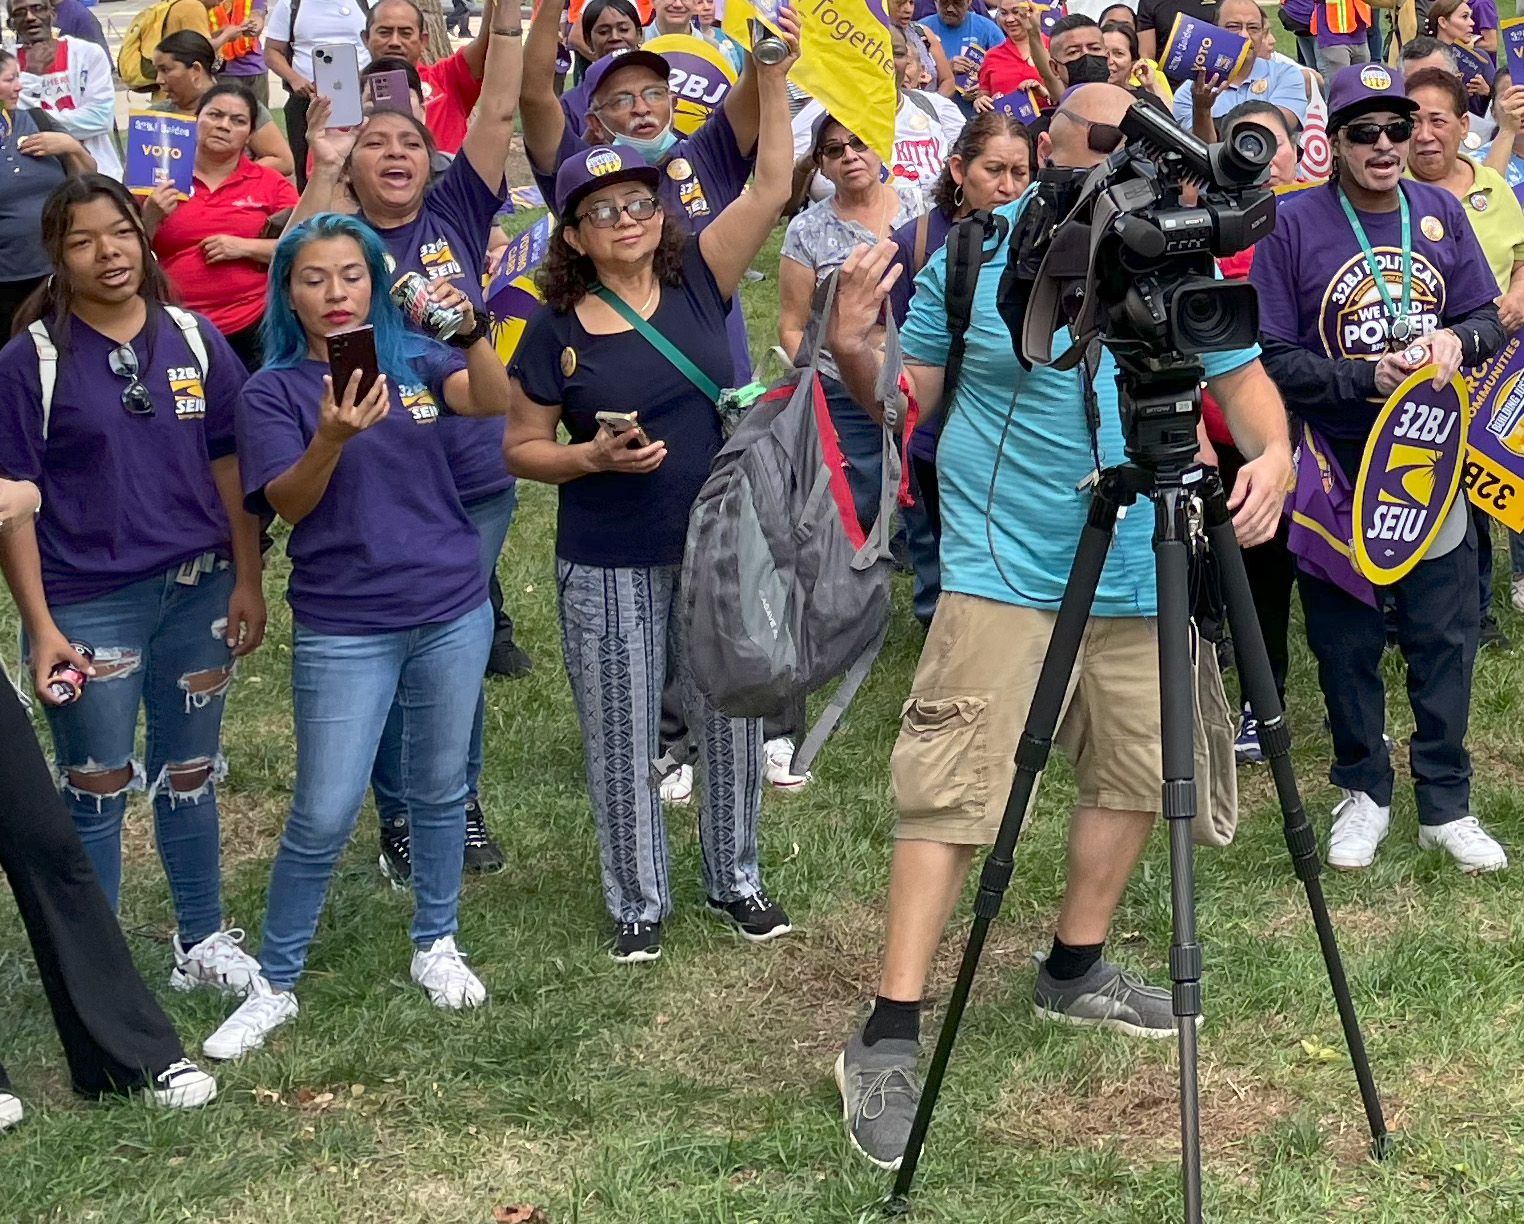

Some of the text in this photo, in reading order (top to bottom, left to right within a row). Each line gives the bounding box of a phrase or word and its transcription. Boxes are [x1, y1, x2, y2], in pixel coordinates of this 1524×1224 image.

[1190, 37, 1214, 72] VOTO
[667, 67, 728, 105] 2BJ
[141, 143, 182, 160] VOTO
[894, 137, 943, 176] KITTY
[428, 261, 462, 280] SEIU
[1331, 264, 1365, 305] 32BJ
[1357, 308, 1382, 322] WE
[167, 367, 201, 381] 32B
[1469, 336, 1522, 424] OMMUNITIES
[1393, 401, 1458, 445] 32BJ
[1490, 394, 1521, 433] BUILDING
[1365, 505, 1428, 544] SEIU
